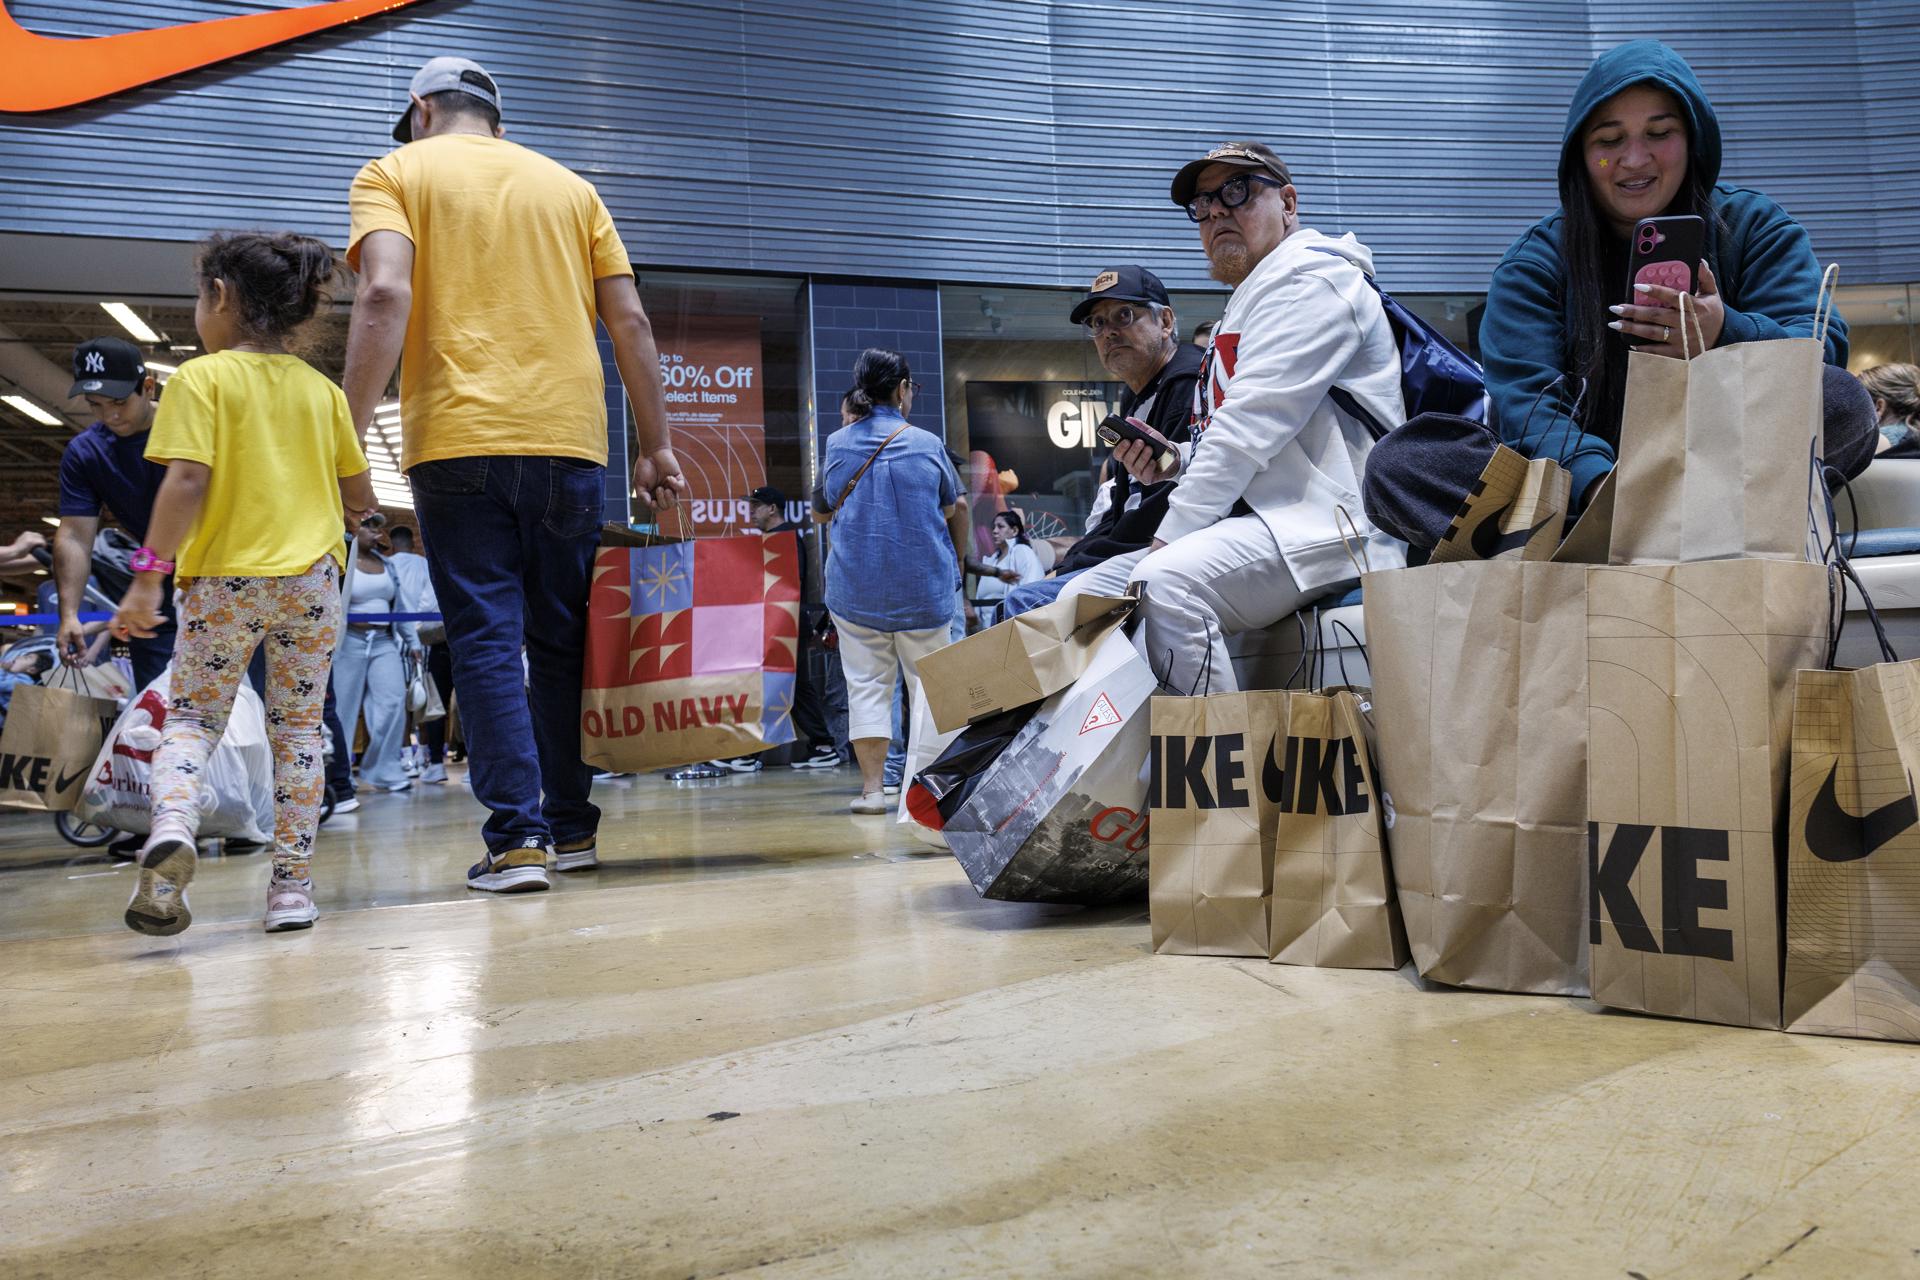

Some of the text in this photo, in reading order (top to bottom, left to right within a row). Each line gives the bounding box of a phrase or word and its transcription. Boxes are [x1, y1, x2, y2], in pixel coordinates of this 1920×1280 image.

[85, 351, 105, 373] NY
[673, 354, 683, 363] to
[660, 365, 753, 389] 60% Off
[664, 391, 738, 404] elect Items
[582, 693, 749, 738] OLD NAVY
[1588, 821, 1734, 961] KE
